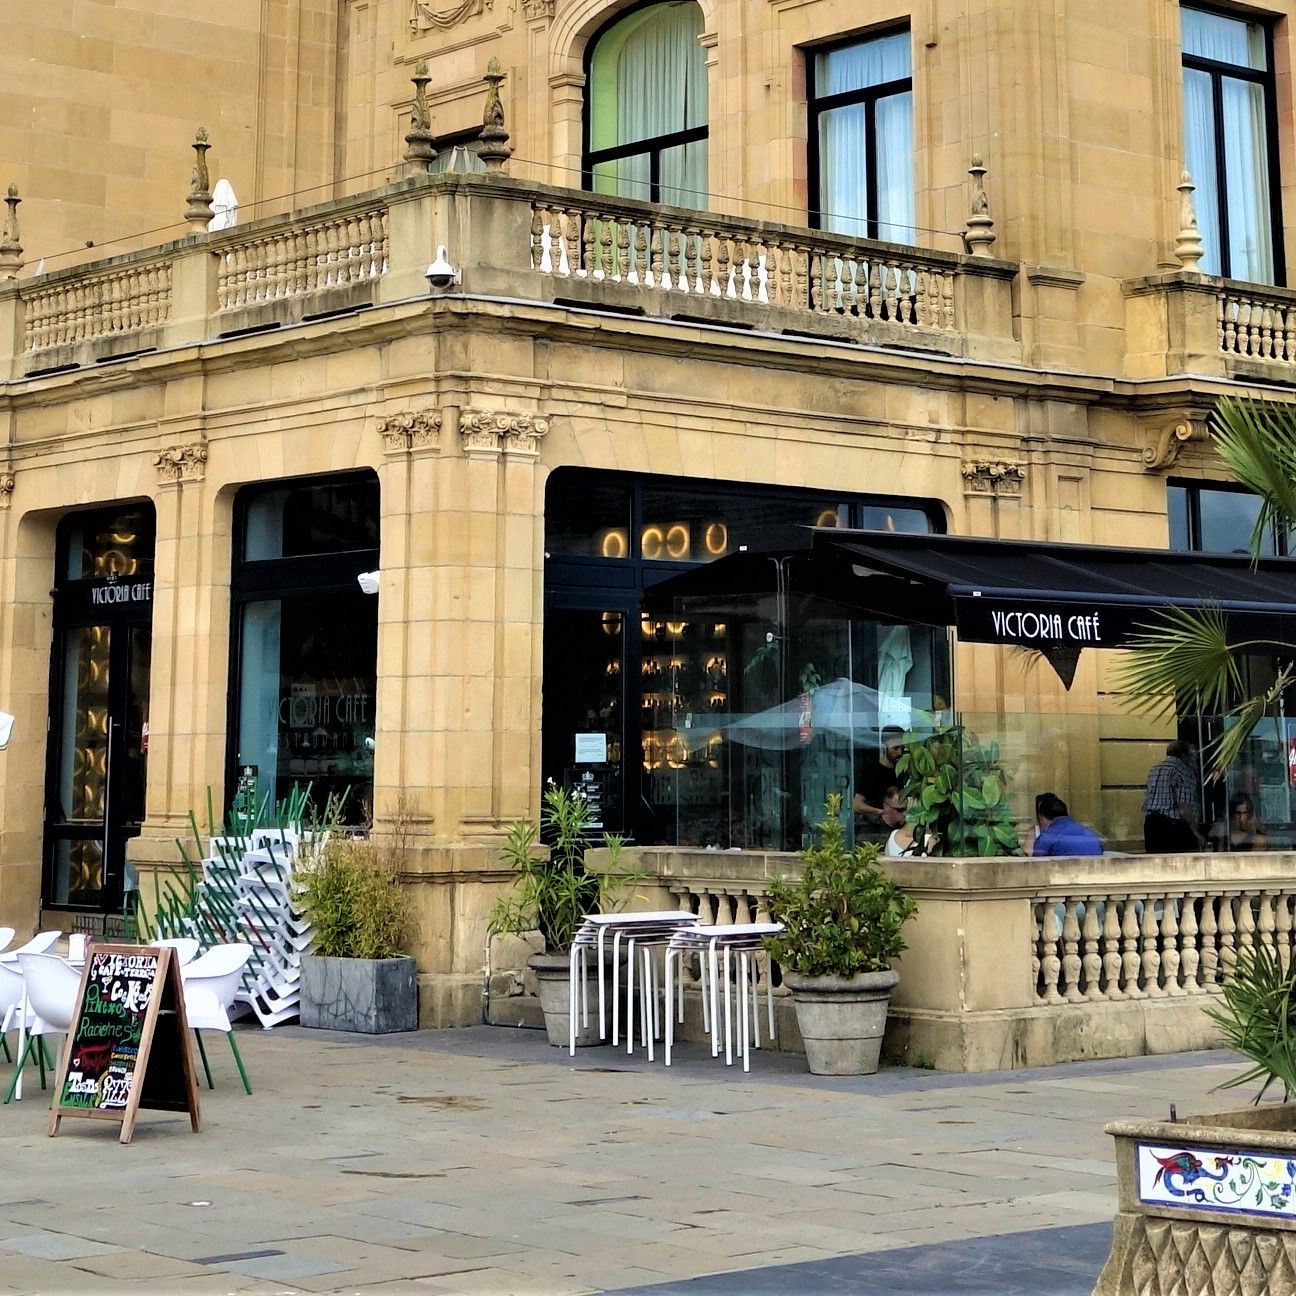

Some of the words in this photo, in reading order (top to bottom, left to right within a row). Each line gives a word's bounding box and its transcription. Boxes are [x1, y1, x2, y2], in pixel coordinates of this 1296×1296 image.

[92, 585, 130, 604] VICTORIA
[991, 610, 1063, 639] VICTORIA
[1067, 611, 1102, 641] CAFÉ
